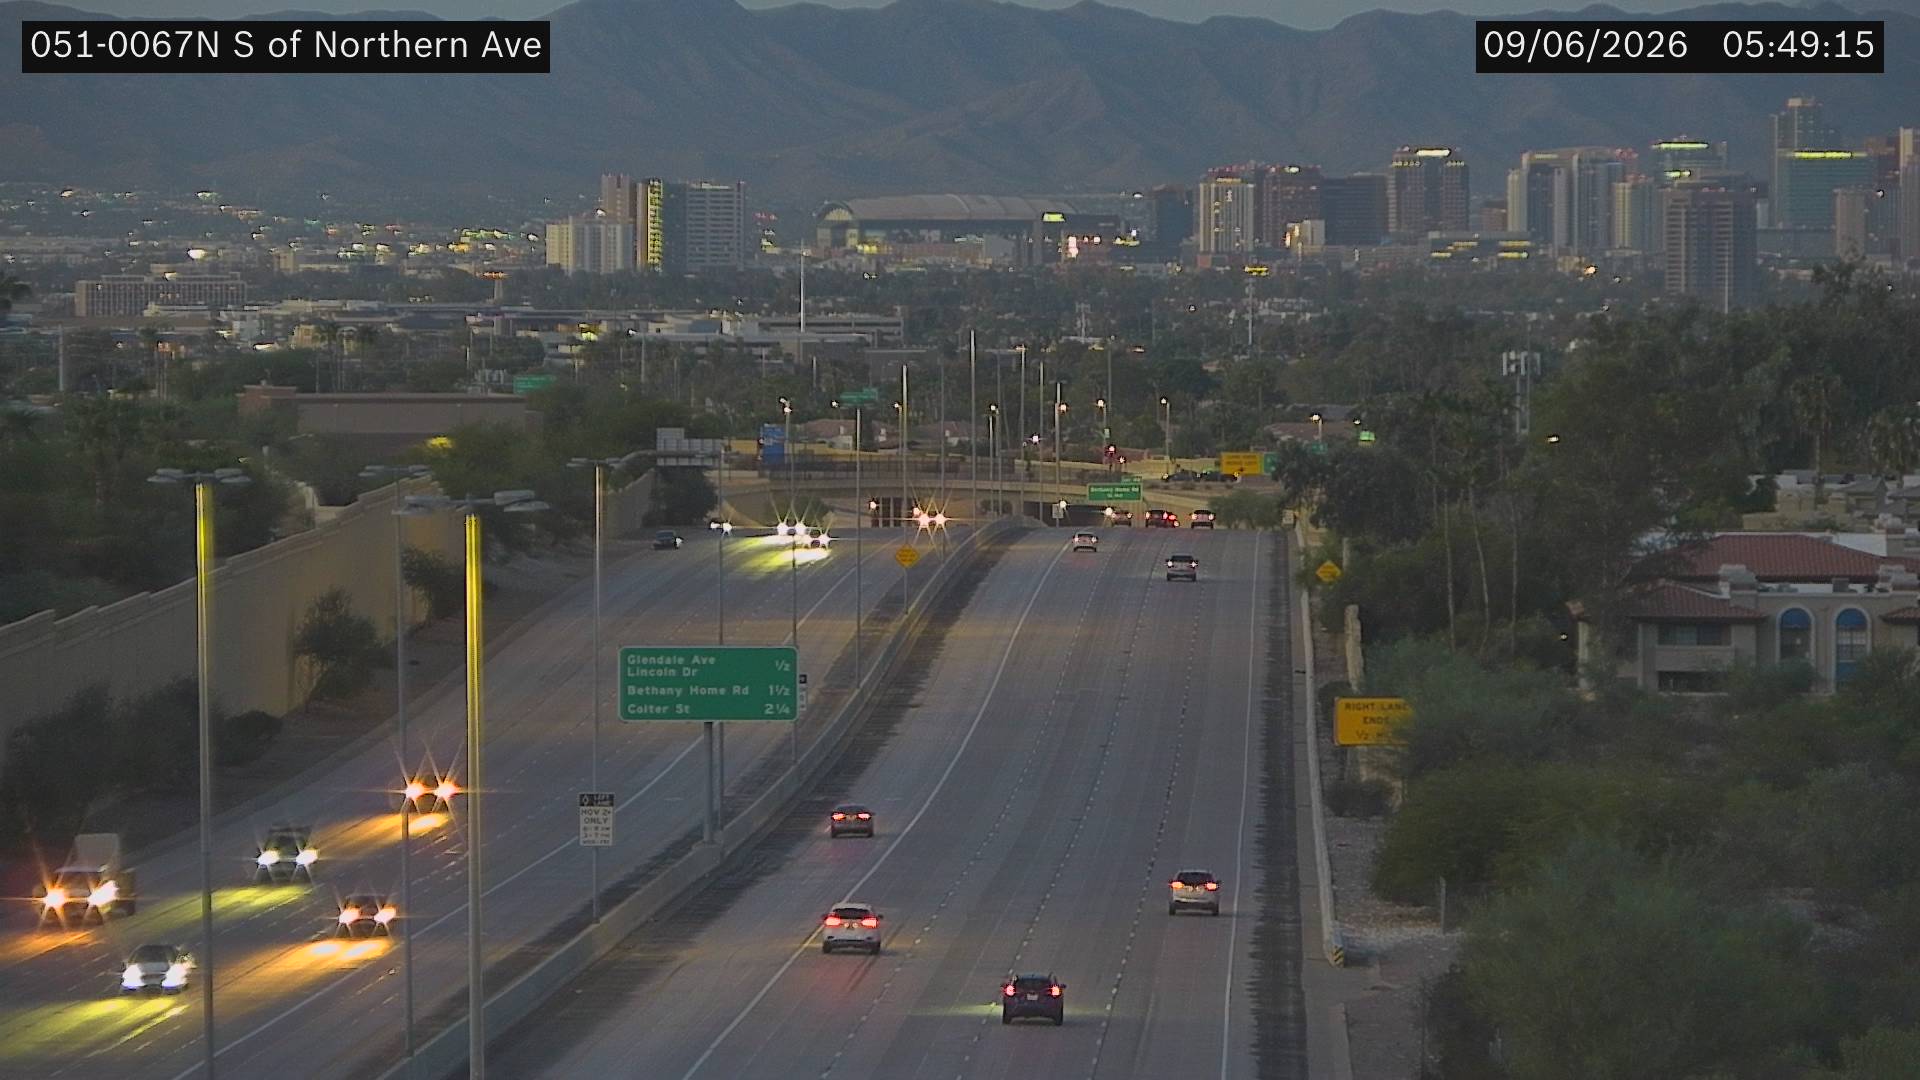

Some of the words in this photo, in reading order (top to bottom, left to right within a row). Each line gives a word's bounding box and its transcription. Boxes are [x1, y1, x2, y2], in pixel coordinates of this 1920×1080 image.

[627, 655, 684, 665] Glendale
[691, 655, 716, 665] Ave
[627, 667, 676, 677] Lincoln
[682, 667, 699, 677] Dr
[627, 685, 683, 697] Bethany
[690, 685, 726, 696] Home
[732, 685, 750, 696] Rd
[627, 704, 669, 714] Colter
[675, 704, 690, 714] St
[1344, 702, 1376, 711] RIGHT
